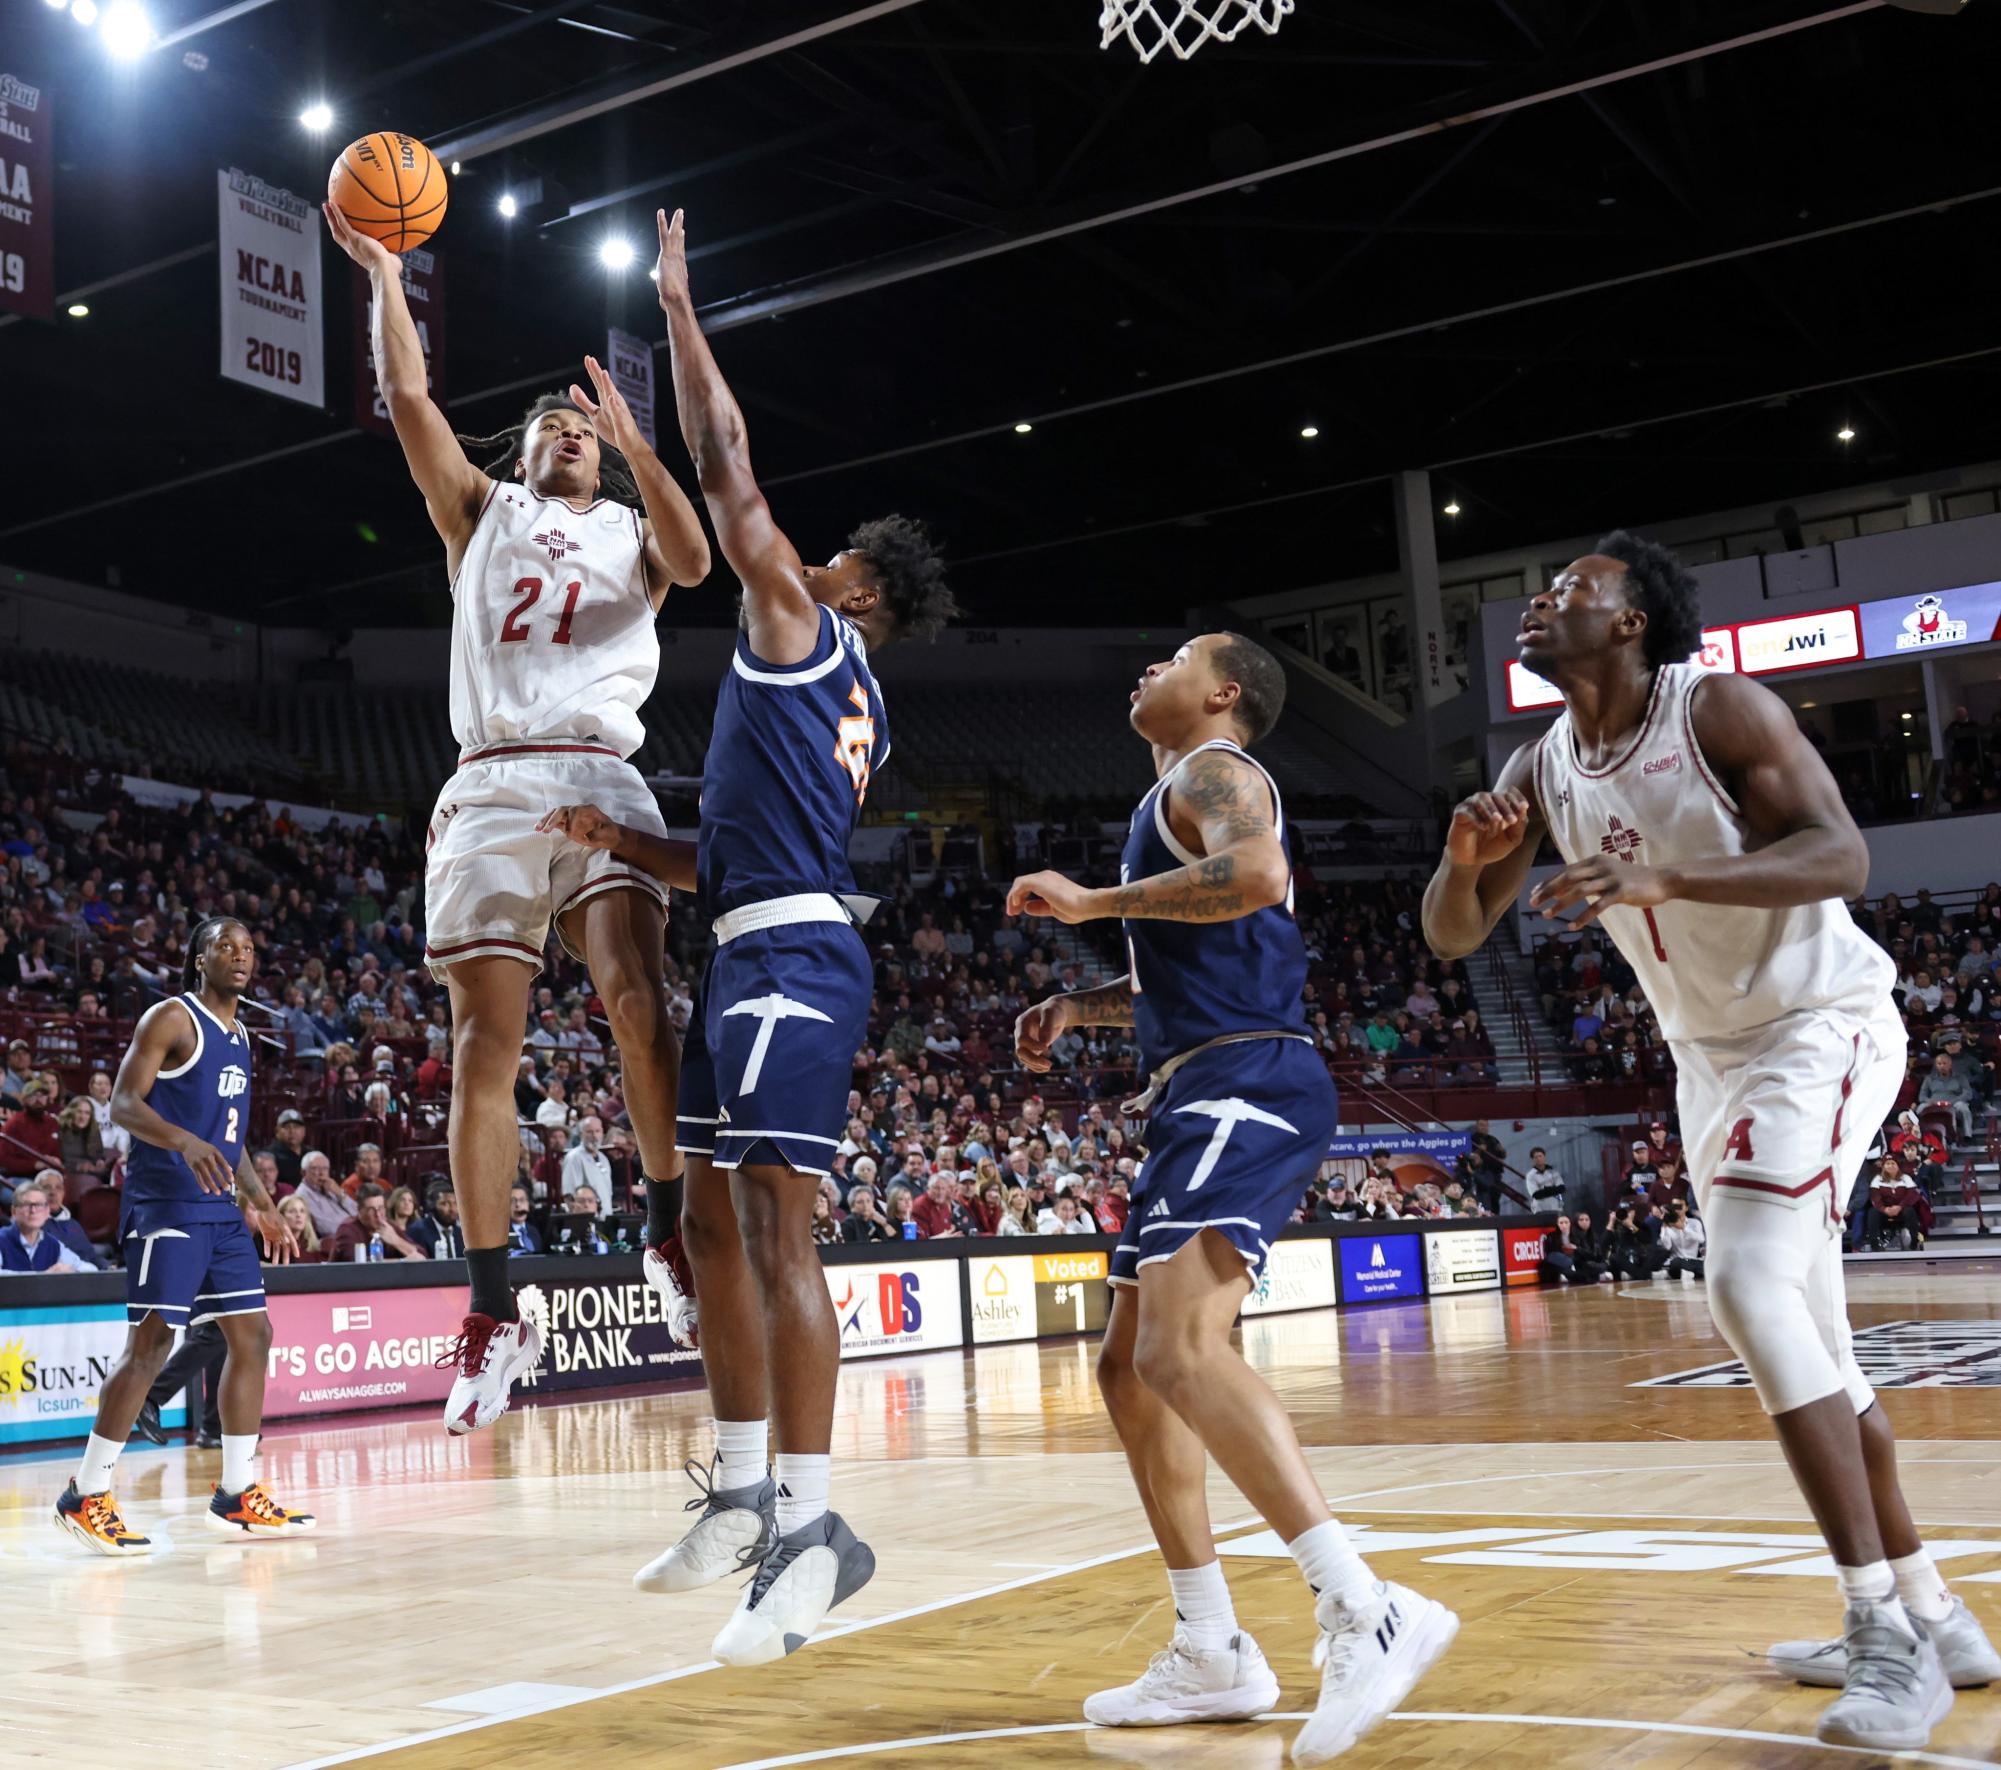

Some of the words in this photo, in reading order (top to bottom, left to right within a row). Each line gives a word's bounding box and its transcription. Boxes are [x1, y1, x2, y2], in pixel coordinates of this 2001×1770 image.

[239, 198, 303, 234] VOLLEYBALL
[237, 248, 306, 304] NCAA
[239, 287, 306, 323] TOURNAMENT
[246, 336, 302, 386] 2019
[500, 577, 582, 645] 21
[1428, 632, 1440, 687] NORTH
[225, 1107, 239, 1144] 2
[1357, 1142, 1370, 1152] go
[1371, 1139, 1400, 1150] where
[1401, 1138, 1416, 1149] the
[1418, 1138, 1449, 1150] Aggies
[1451, 1137, 1467, 1148] go!
[1045, 1258, 1100, 1278] Voted
[1513, 1240, 1540, 1262] CIRCLE
[1055, 1283, 1086, 1331] #1
[1274, 1279, 1308, 1302] BANK
[973, 1299, 1021, 1323] Ashley
[315, 1342, 357, 1375] GO
[298, 1382, 406, 1404] ALWAYSANAGGIE.COM
